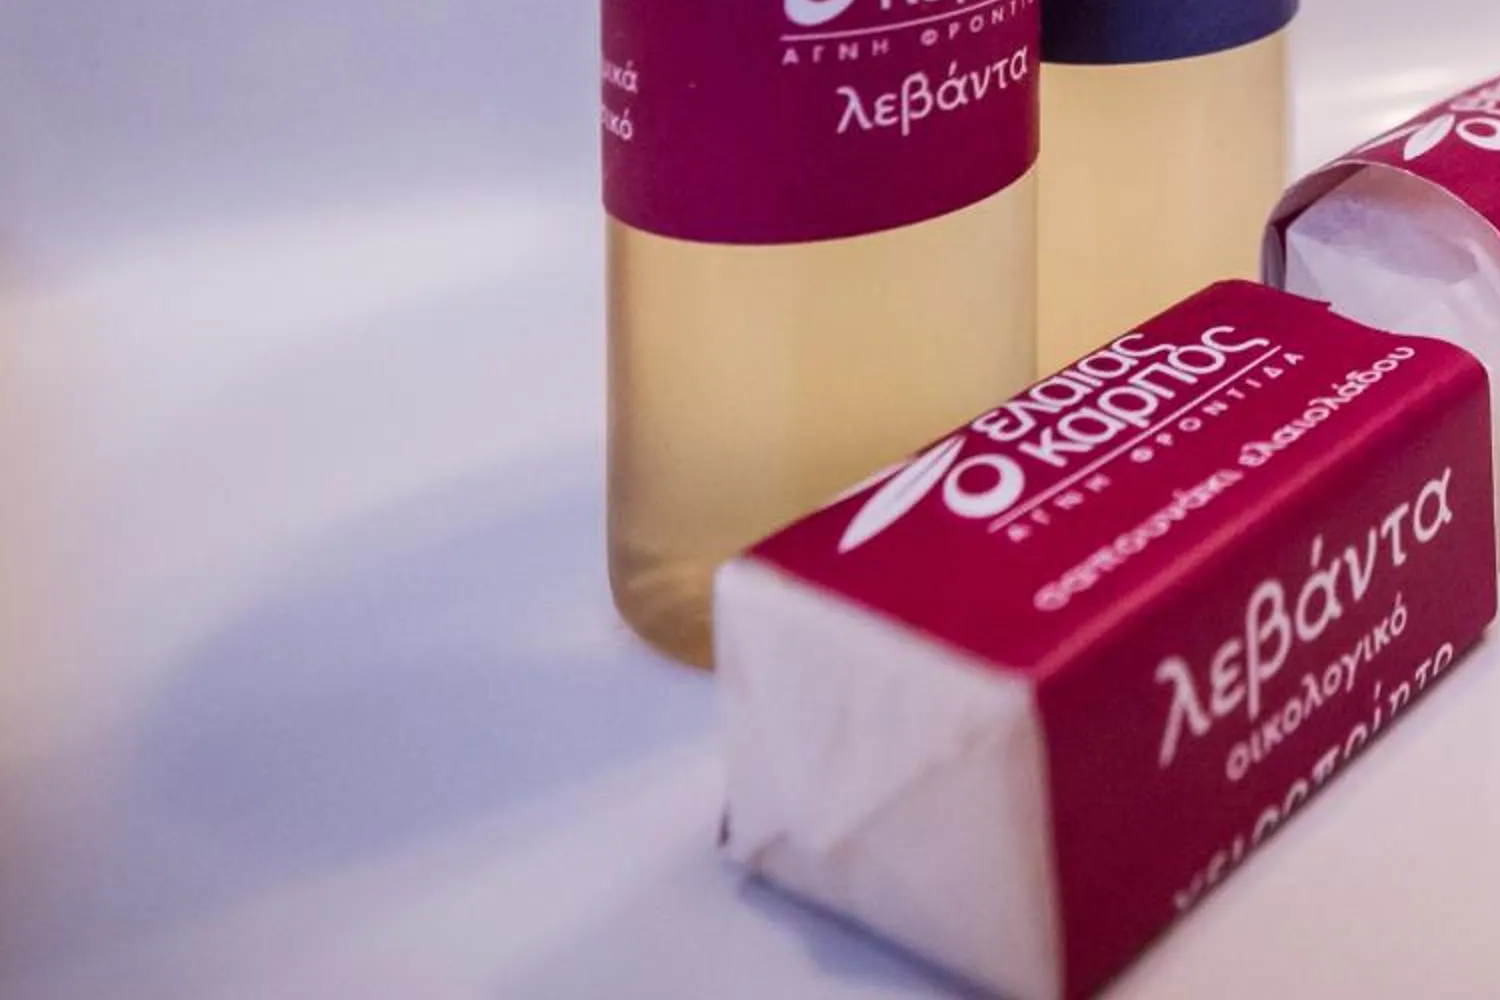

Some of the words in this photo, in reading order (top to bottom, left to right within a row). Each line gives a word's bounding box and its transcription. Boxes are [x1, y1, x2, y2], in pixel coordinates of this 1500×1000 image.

[781, 38, 890, 66] ΑΓΝΗ
[835, 45, 1029, 136] λεβάντα
[1129, 351, 1304, 463] ΦΡΟΝΤΙΔΑ
[1155, 467, 1454, 770] λεβάντα
[1225, 591, 1409, 783] οικολογικό
